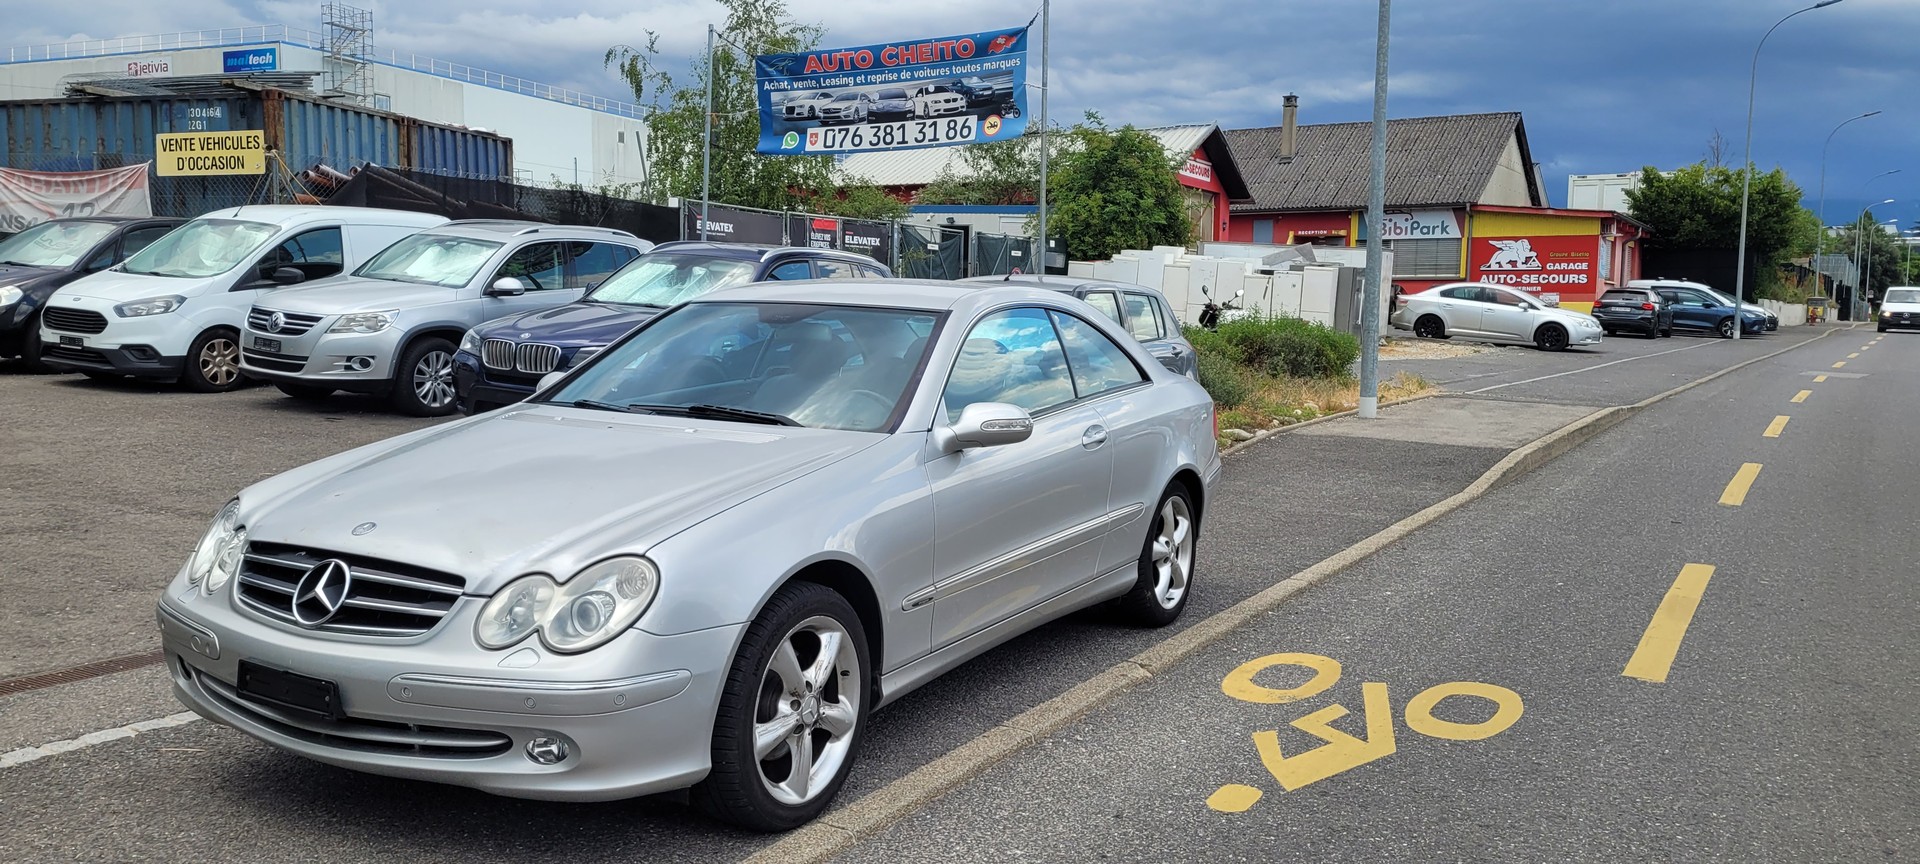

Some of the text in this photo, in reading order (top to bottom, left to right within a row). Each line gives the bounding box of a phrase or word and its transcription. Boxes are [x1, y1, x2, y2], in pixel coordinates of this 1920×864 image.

[227, 52, 273, 66] maltech
[804, 38, 976, 74] AUTO CHEITO
[139, 60, 169, 76] jetivia
[763, 57, 1021, 91] Achat, vente, Leasing et reprise de voitures toutes marques
[823, 117, 973, 149] 076 381 31 86
[160, 135, 261, 152] VENTE VEHICULES
[176, 155, 245, 171] D'OCCASION
[696, 220, 735, 233] EEVATEX
[845, 234, 881, 246] ELEVATEX
[1546, 262, 1589, 270] GARAGE
[1479, 273, 1588, 284] AUTO-SECOURS
